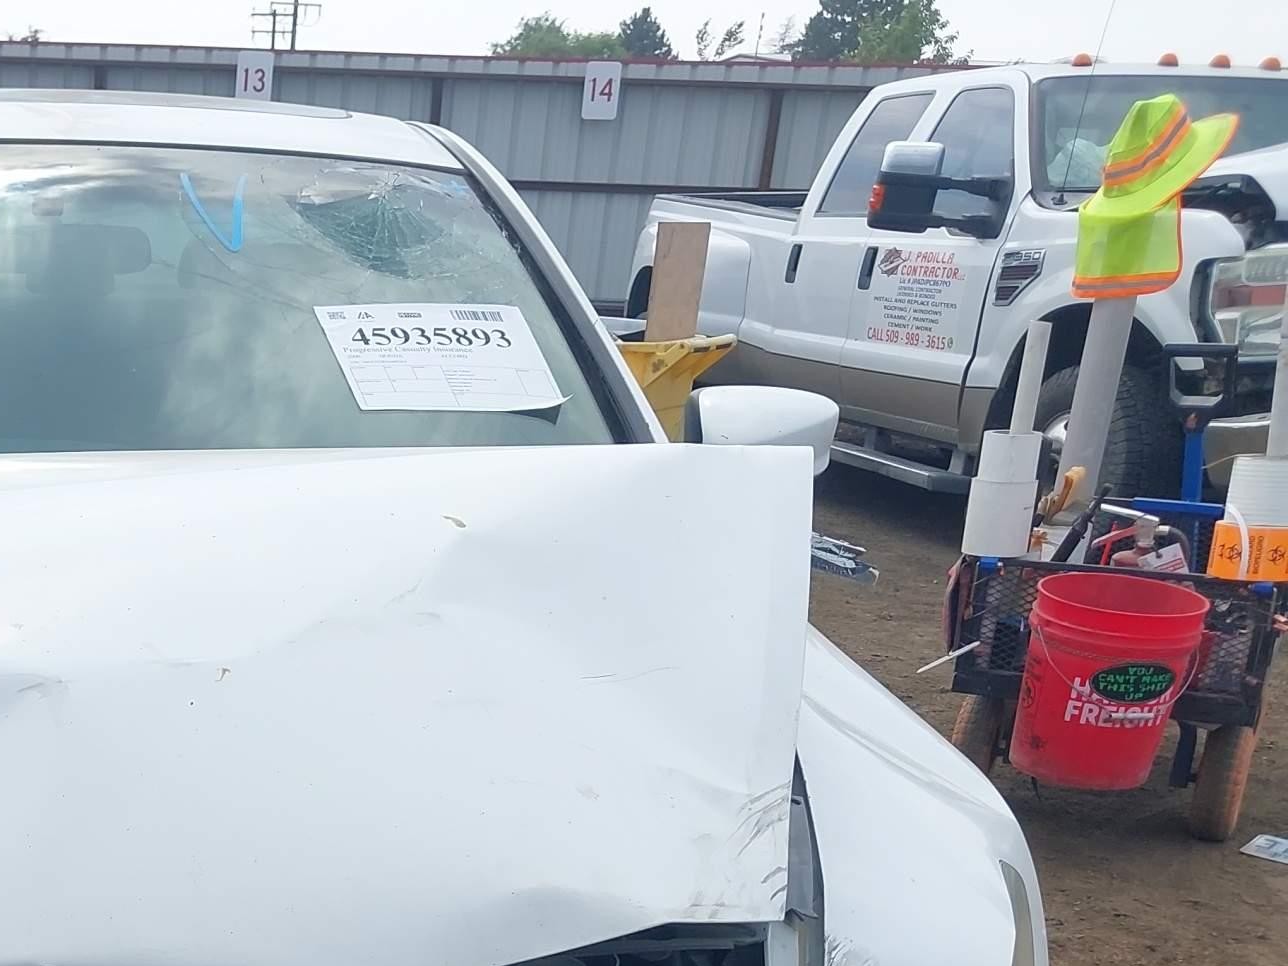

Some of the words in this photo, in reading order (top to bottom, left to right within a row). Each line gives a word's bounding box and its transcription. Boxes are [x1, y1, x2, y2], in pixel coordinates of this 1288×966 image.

[242, 67, 266, 93] 13
[589, 76, 615, 103] 14
[915, 251, 956, 265] PADILLA
[900, 264, 960, 280] CONTRACTOR
[907, 299, 930, 307] REPLACE
[930, 301, 957, 309] GUTTERS
[913, 308, 942, 316] WINDOWS
[883, 313, 907, 321] CERAMIC
[912, 316, 939, 324] PAINTING
[887, 321, 910, 329] CEMENT
[351, 326, 512, 348] 45935893
[867, 327, 884, 341] CALL
[885, 329, 899, 343] 509
[905, 331, 920, 346] 989
[925, 334, 946, 350] 3615
[1098, 674, 1138, 683] CAN'T
[1099, 682, 1135, 692] THIS
